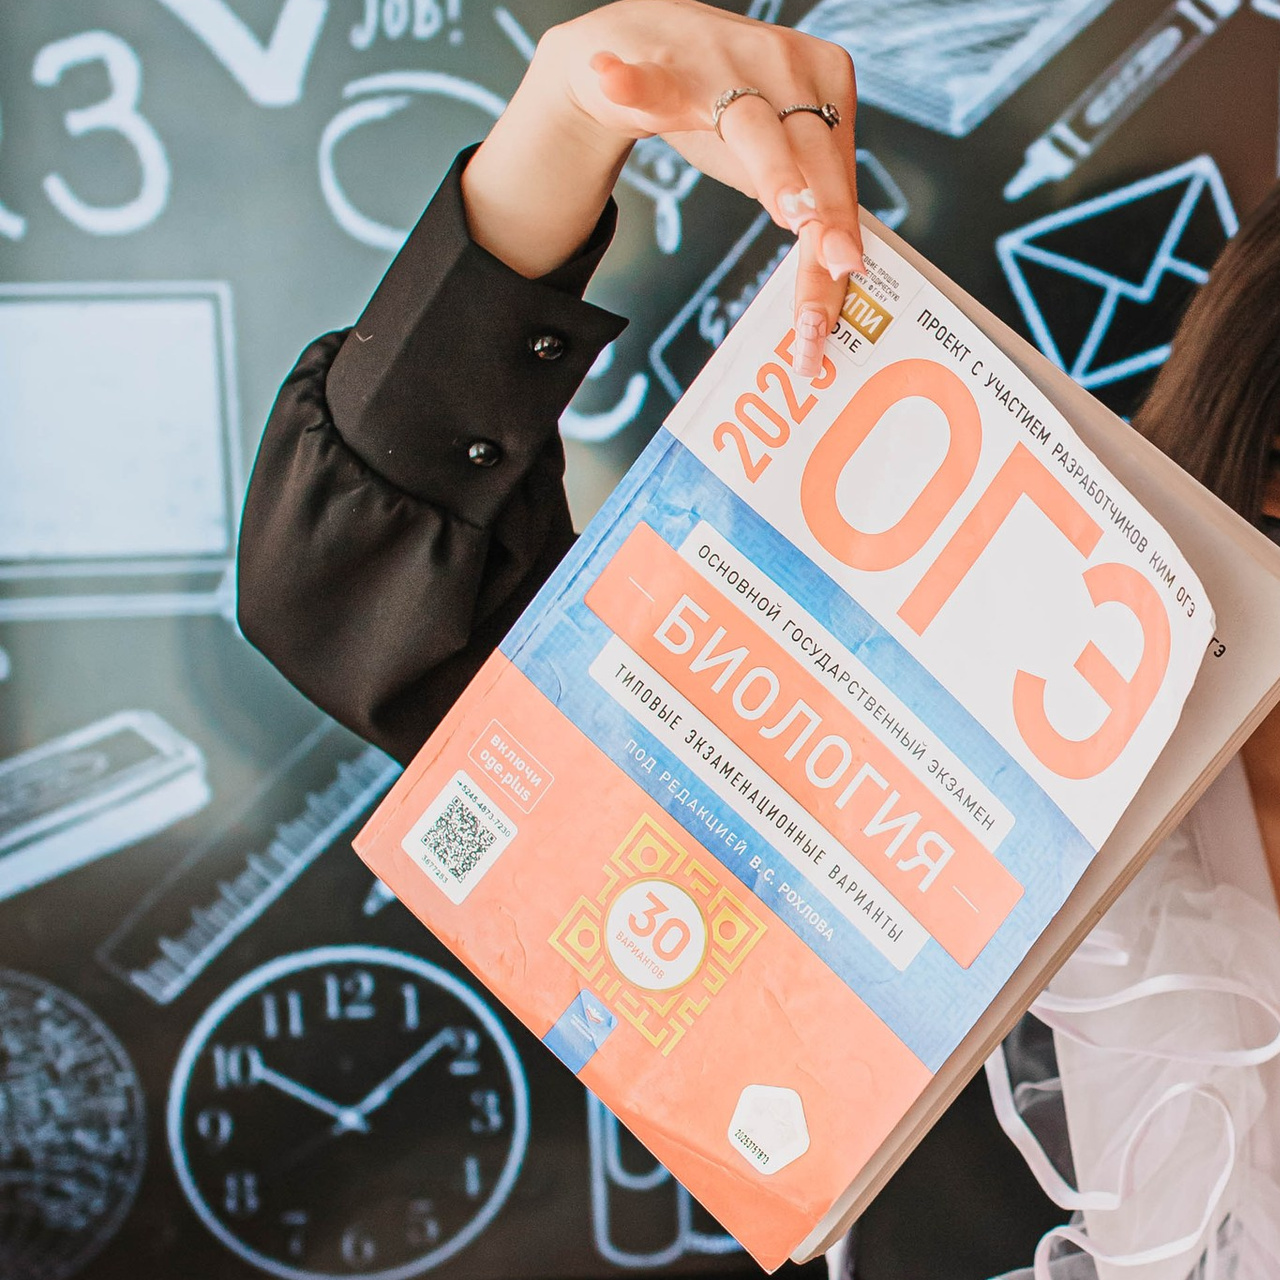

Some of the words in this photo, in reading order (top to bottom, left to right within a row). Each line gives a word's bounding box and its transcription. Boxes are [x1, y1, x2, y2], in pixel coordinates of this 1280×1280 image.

[916, 309, 971, 363] ПРОЕКТ
[970, 360, 984, 376] С
[984, 373, 1052, 446] УЧАСТИЕМ
[1051, 442, 1149, 554] РАЗРАБОТЧИКОВ
[1148, 551, 1176, 589] КИМ
[1176, 586, 1197, 619] ОГЭ
[800, 358, 1172, 780] ОГЭ
[698, 544, 782, 622] ОСНОВНОЙ
[782, 619, 928, 761] ГОСУДАРСТВЕННЫЙ
[927, 759, 996, 831] ЭКЗАМЕН
[490, 734, 542, 787] включи
[653, 593, 956, 893] БИОЛОГИЯ
[480, 749, 531, 802] oge.plus
[614, 663, 683, 731] ТИПОВЫЕ
[684, 729, 826, 866] ЭКЗАМЕНАЦИОННЫЕ
[828, 865, 903, 943] ВАРИАНТЫ
[624, 738, 656, 773] ПОД
[658, 770, 749, 856] РЕДАКЦИЕЙ
[777, 881, 834, 942] РОХЛОВА
[615, 931, 665, 981] ВАРИАНТОВ
[628, 891, 691, 962] 30
[262, 989, 304, 1039] 11
[324, 969, 376, 1020] 12
[401, 981, 420, 1031] 1
[213, 1043, 266, 1091] 10
